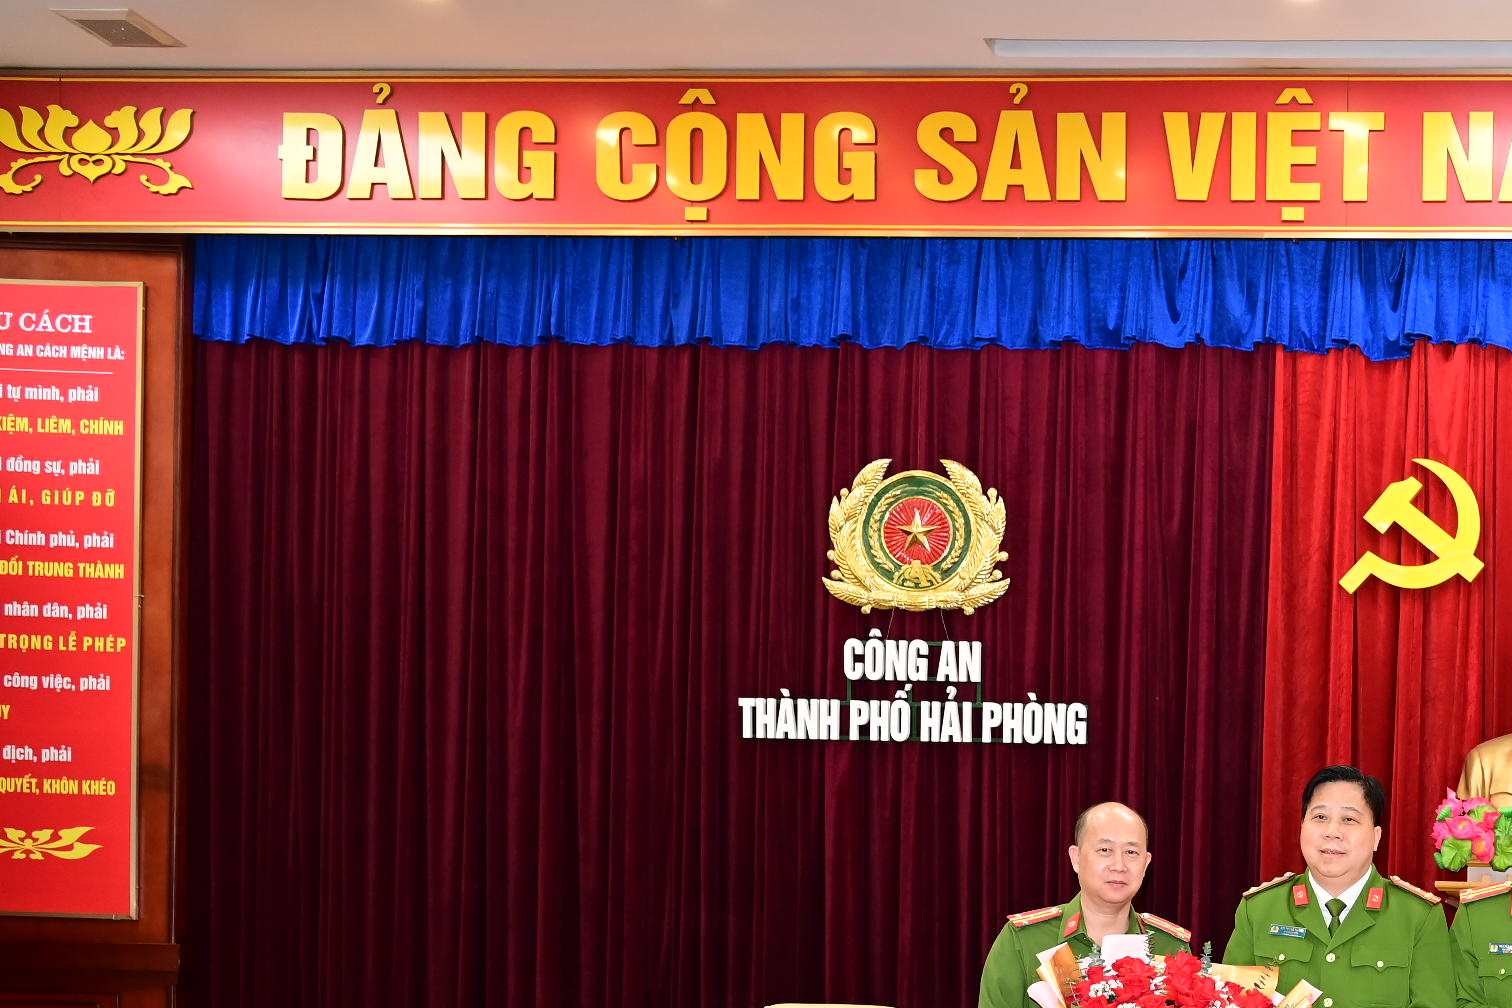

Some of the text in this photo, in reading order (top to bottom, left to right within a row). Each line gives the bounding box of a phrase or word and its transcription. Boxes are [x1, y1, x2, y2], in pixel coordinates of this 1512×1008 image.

[277, 82, 557, 201] ĐẢNG
[594, 88, 878, 221] CỘNG
[914, 82, 1127, 202] SẢN
[1162, 87, 1386, 222] VIỆT
[18, 309, 93, 333] CÁCH
[0, 343, 125, 361] NG AN CÁCH MỆNH LÀ:
[7, 384, 22, 402] tự
[25, 385, 65, 402] mình,
[68, 385, 99, 402] phải
[37, 415, 76, 436] LIÊM,
[79, 417, 124, 435] CHÍNH
[6, 455, 41, 475] đồng
[44, 459, 66, 477] sự,
[69, 458, 100, 476] phải
[8, 485, 116, 507] ÁI, GIÚP ĐỠ
[5, 529, 115, 549] Chính phủ, phải
[27, 561, 74, 578] TRUNG
[78, 560, 125, 579] THÀNH
[4, 601, 108, 620] nhân dân, phải
[58, 631, 78, 651] LỄ
[83, 634, 127, 652] PHÉP
[843, 628, 983, 683] CÔNG AN
[3, 672, 111, 693] công việc, phải
[738, 683, 1089, 745] THÀNH PHỐ HẢI PHÒNG
[2, 745, 72, 763] địch, phải
[43, 776, 79, 795] KHÔN
[82, 778, 116, 796] KHÉO
